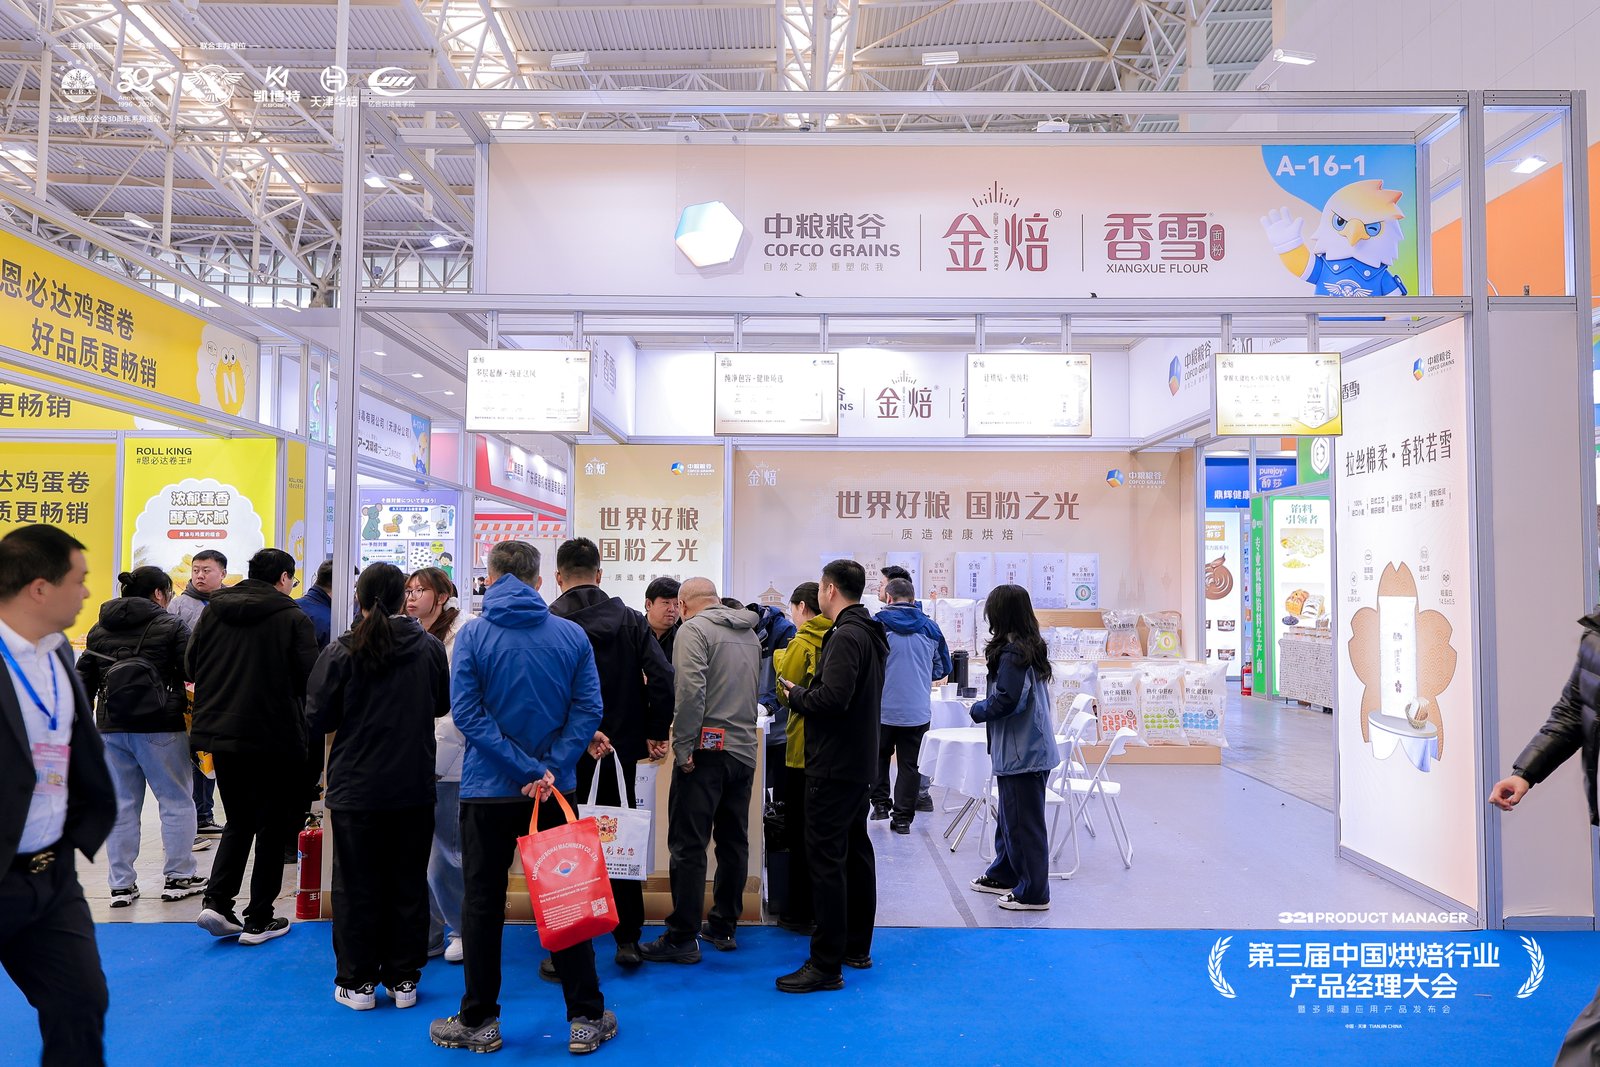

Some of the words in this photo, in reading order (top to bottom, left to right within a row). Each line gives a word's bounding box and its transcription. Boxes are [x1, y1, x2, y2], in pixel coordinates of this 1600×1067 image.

[1276, 155, 1365, 176] A-16-1
[764, 213, 886, 239] 中粮粮谷
[1103, 213, 1207, 260] 香雪
[764, 244, 824, 257] COFCO
[829, 244, 900, 257] GRAINS
[942, 213, 1049, 271] 金焙
[1211, 229, 1224, 256] 面粉
[764, 262, 817, 272] 自然之源
[831, 262, 883, 272] 重塑你我
[1106, 264, 1166, 273] XIANGXUE
[1170, 264, 1209, 273] FLOUR
[0, 258, 134, 341] 恩必达鸡蛋卷
[31, 318, 157, 388] 好品质更畅销
[1184, 340, 1212, 368] 中粮粮谷
[1427, 350, 1451, 365] 中粮粮谷
[876, 387, 932, 418] 金焙
[136, 447, 164, 456] ROLL
[166, 447, 192, 456] KING
[136, 456, 192, 465] #恩必达卷王#
[748, 469, 777, 487] 金焙
[1128, 471, 1162, 479] 中粮粮谷
[171, 491, 230, 506] 浓郁蛋香
[836, 490, 950, 520] 世界好粮
[966, 491, 1080, 520] 国粉之光
[169, 510, 229, 525] 醇香不腻
[599, 507, 699, 531] 世界好粮
[901, 528, 1014, 541] 质造健康烘焙
[599, 538, 698, 562] 国粉之光
